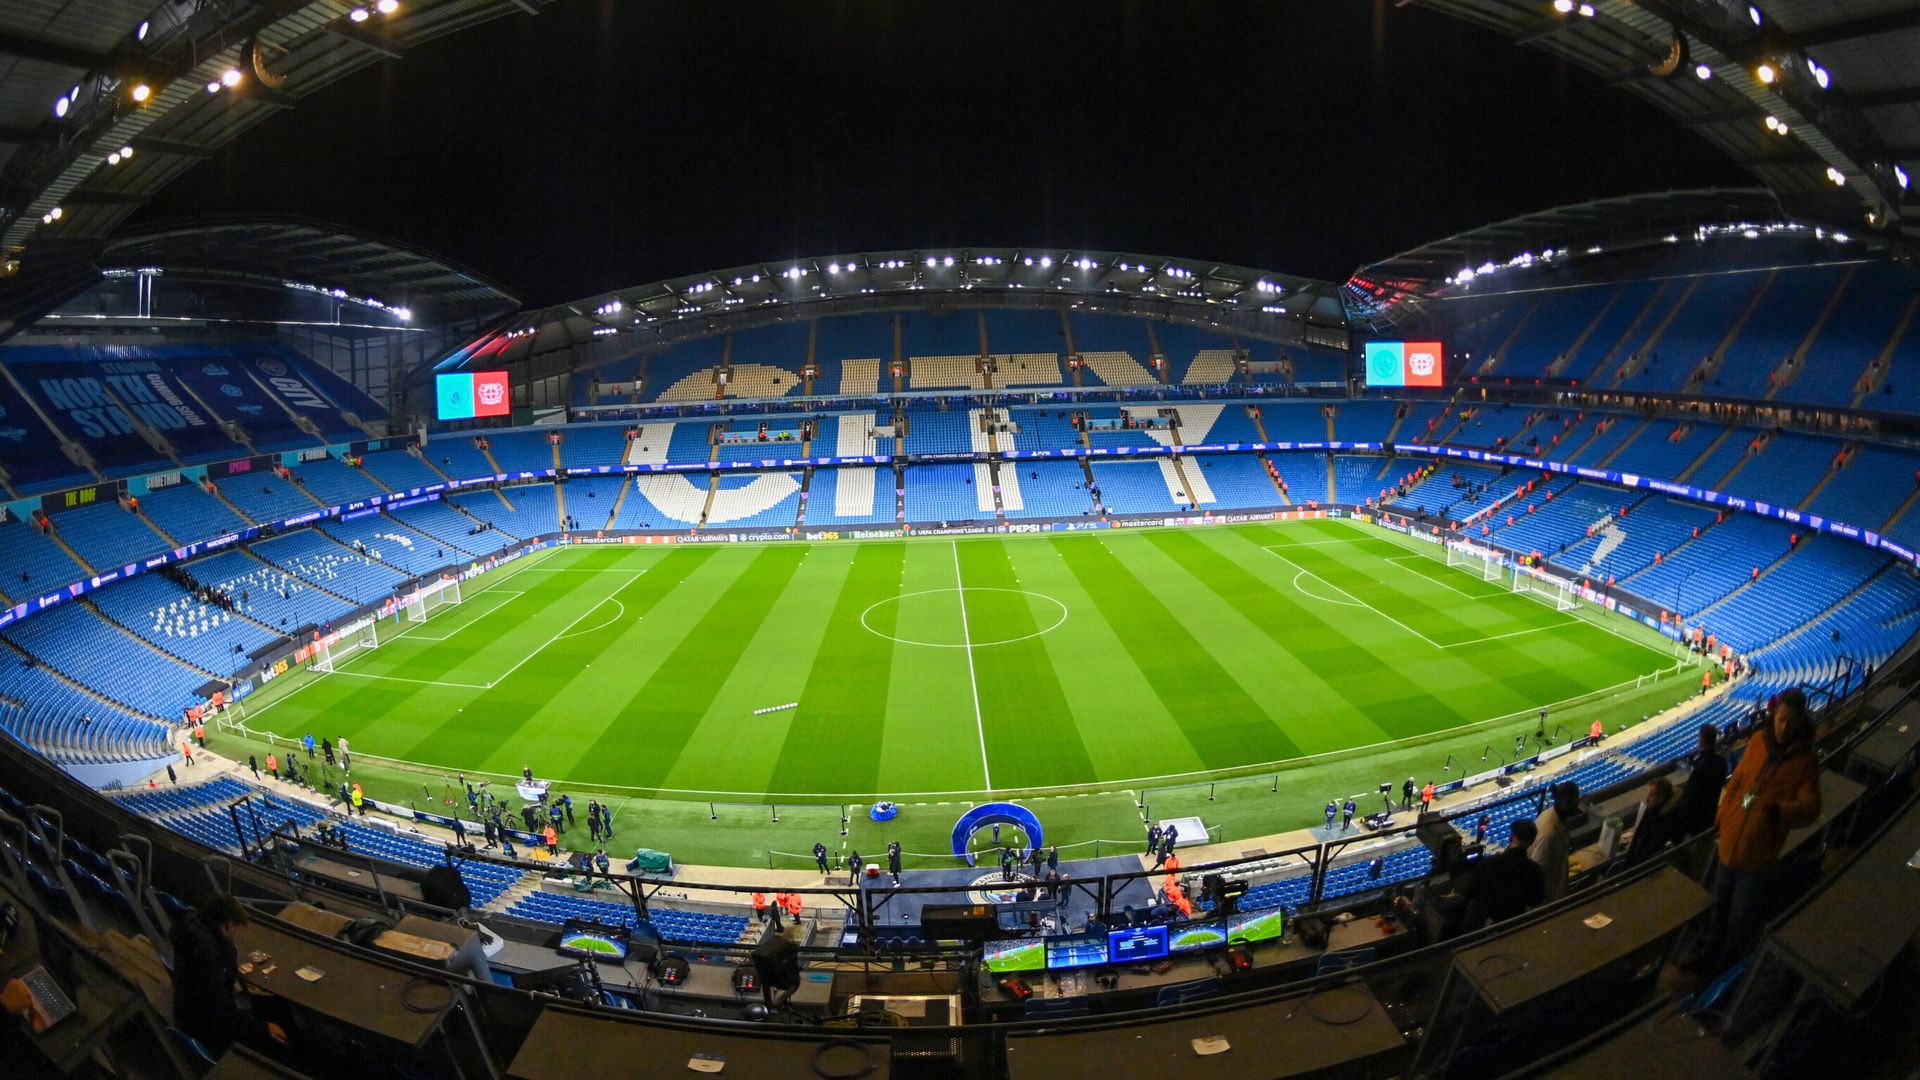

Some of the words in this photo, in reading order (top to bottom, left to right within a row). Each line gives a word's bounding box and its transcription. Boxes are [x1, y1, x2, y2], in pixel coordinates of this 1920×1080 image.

[39, 374, 160, 410] NORTH
[268, 377, 331, 409] CITY
[146, 373, 184, 406] COMING
[174, 405, 207, 426] SOON
[70, 402, 187, 439] STAND
[367, 440, 381, 451] SOON
[297, 451, 304, 462] IS
[305, 448, 327, 460] COMING
[228, 459, 251, 474] SPECIAL
[1577, 468, 1599, 477] MANCHESTER
[147, 471, 181, 489] SOMETHING
[65, 492, 77, 507] THE
[1122, 519, 1163, 527] mastercard
[1227, 514, 1248, 523] QATAR
[1249, 513, 1274, 521] AIRWAYS
[1009, 524, 1040, 533] PEPSI
[1382, 521, 1407, 533] crypto.com
[748, 534, 790, 542] crypto.com
[806, 531, 839, 540] bet365
[854, 530, 896, 539] Heineken
[1410, 527, 1437, 544] Heineken
[207, 537, 231, 548] MANCHESTER
[499, 551, 521, 565] crypto.com
[464, 564, 485, 580] PEPSI
[261, 659, 289, 683] bet365
